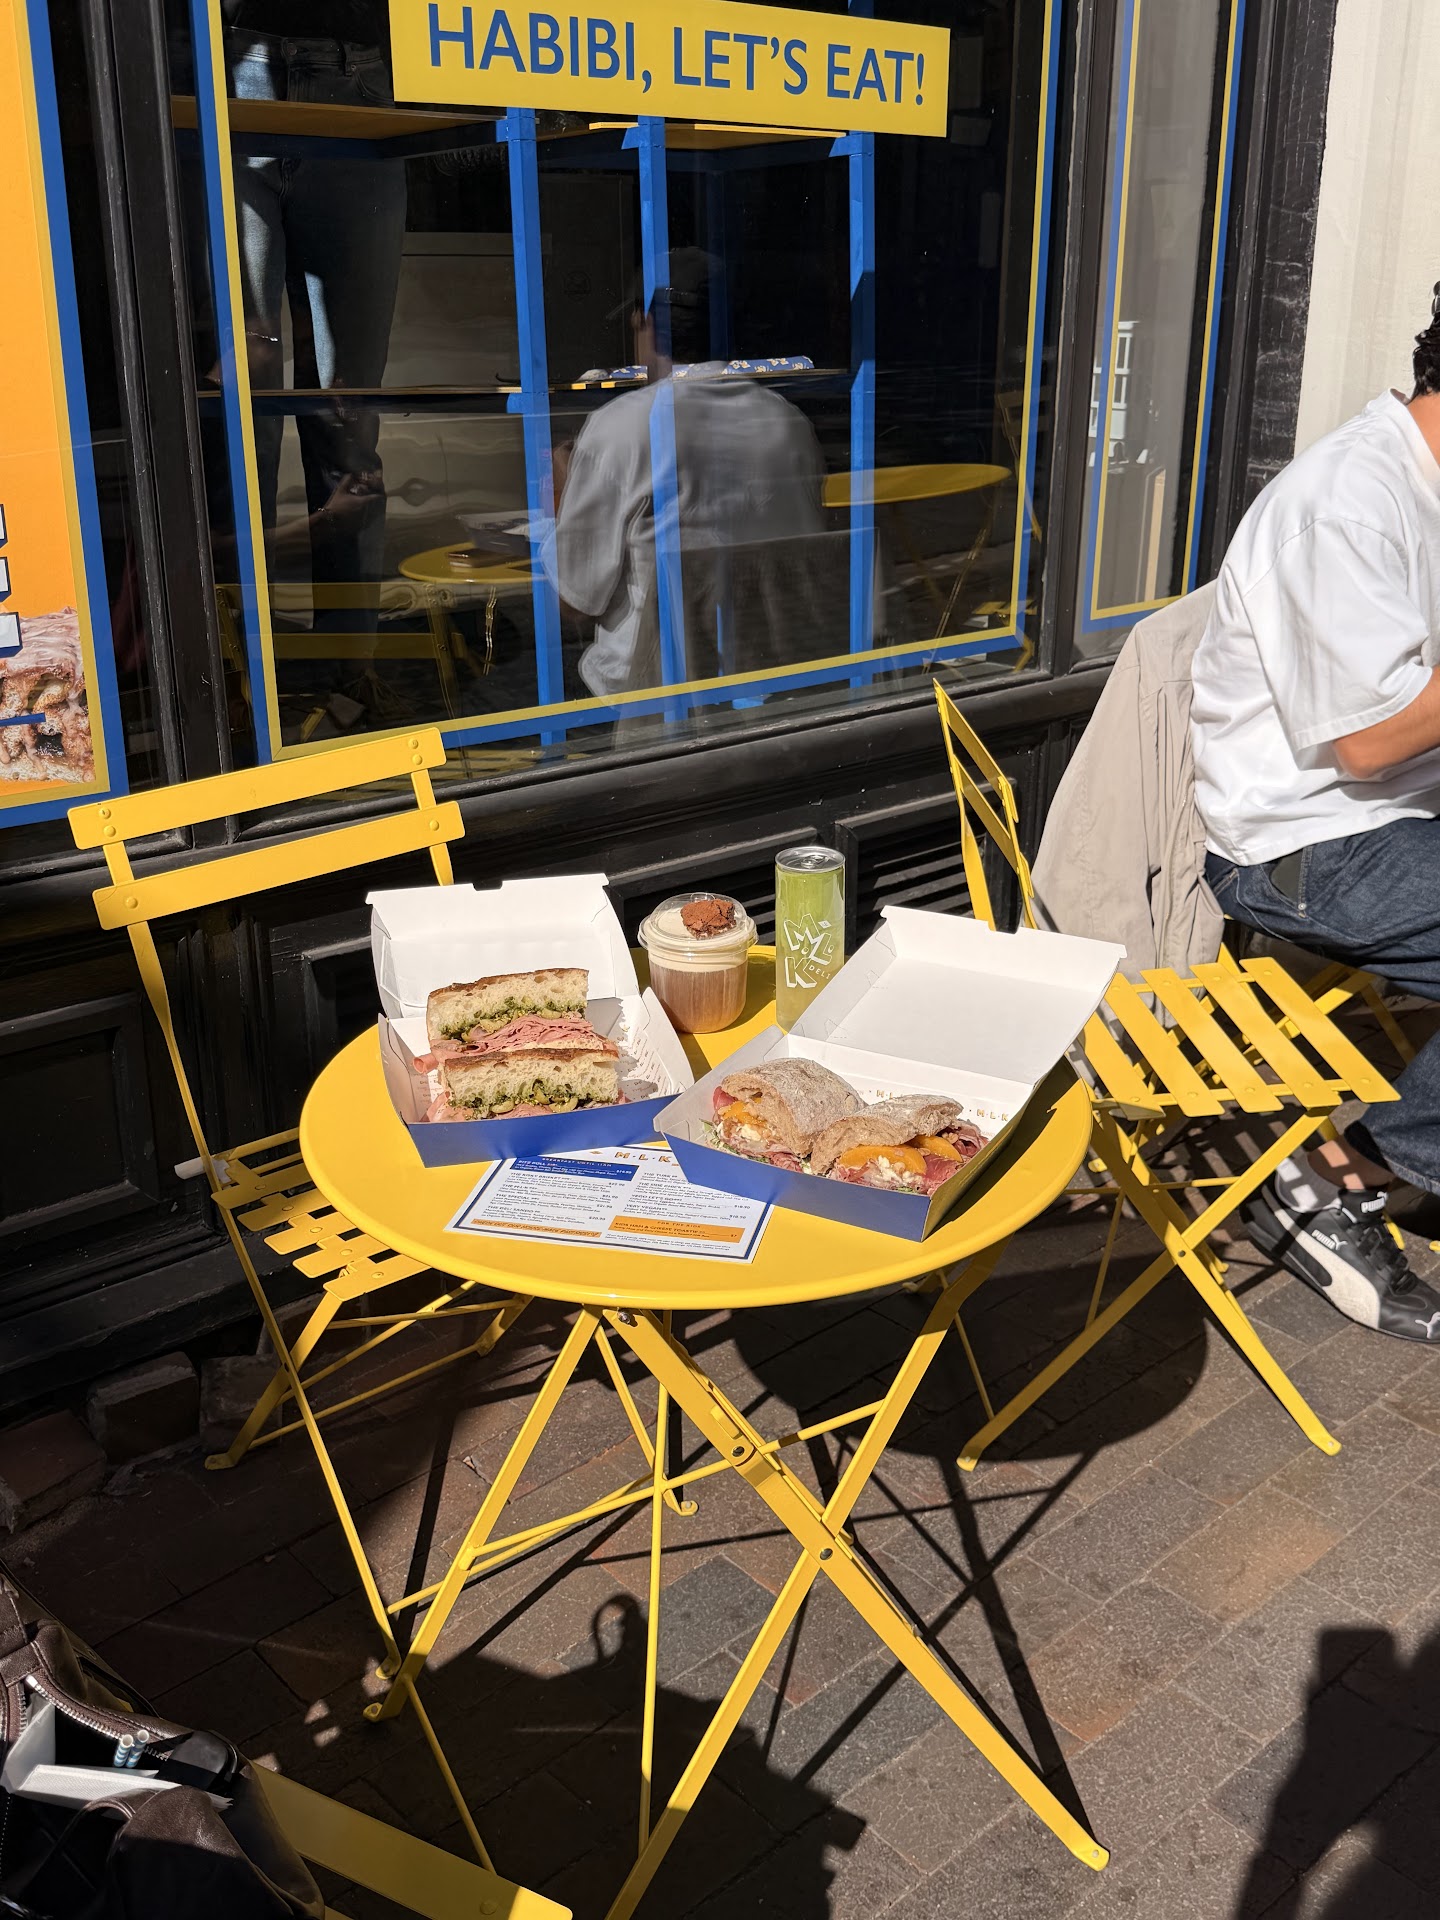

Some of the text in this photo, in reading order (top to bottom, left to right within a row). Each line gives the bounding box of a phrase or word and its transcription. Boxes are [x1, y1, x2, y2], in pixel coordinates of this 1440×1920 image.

[427, 2, 925, 106] HABIBI, LET'S EAT!
[809, 965, 831, 979] DELI
